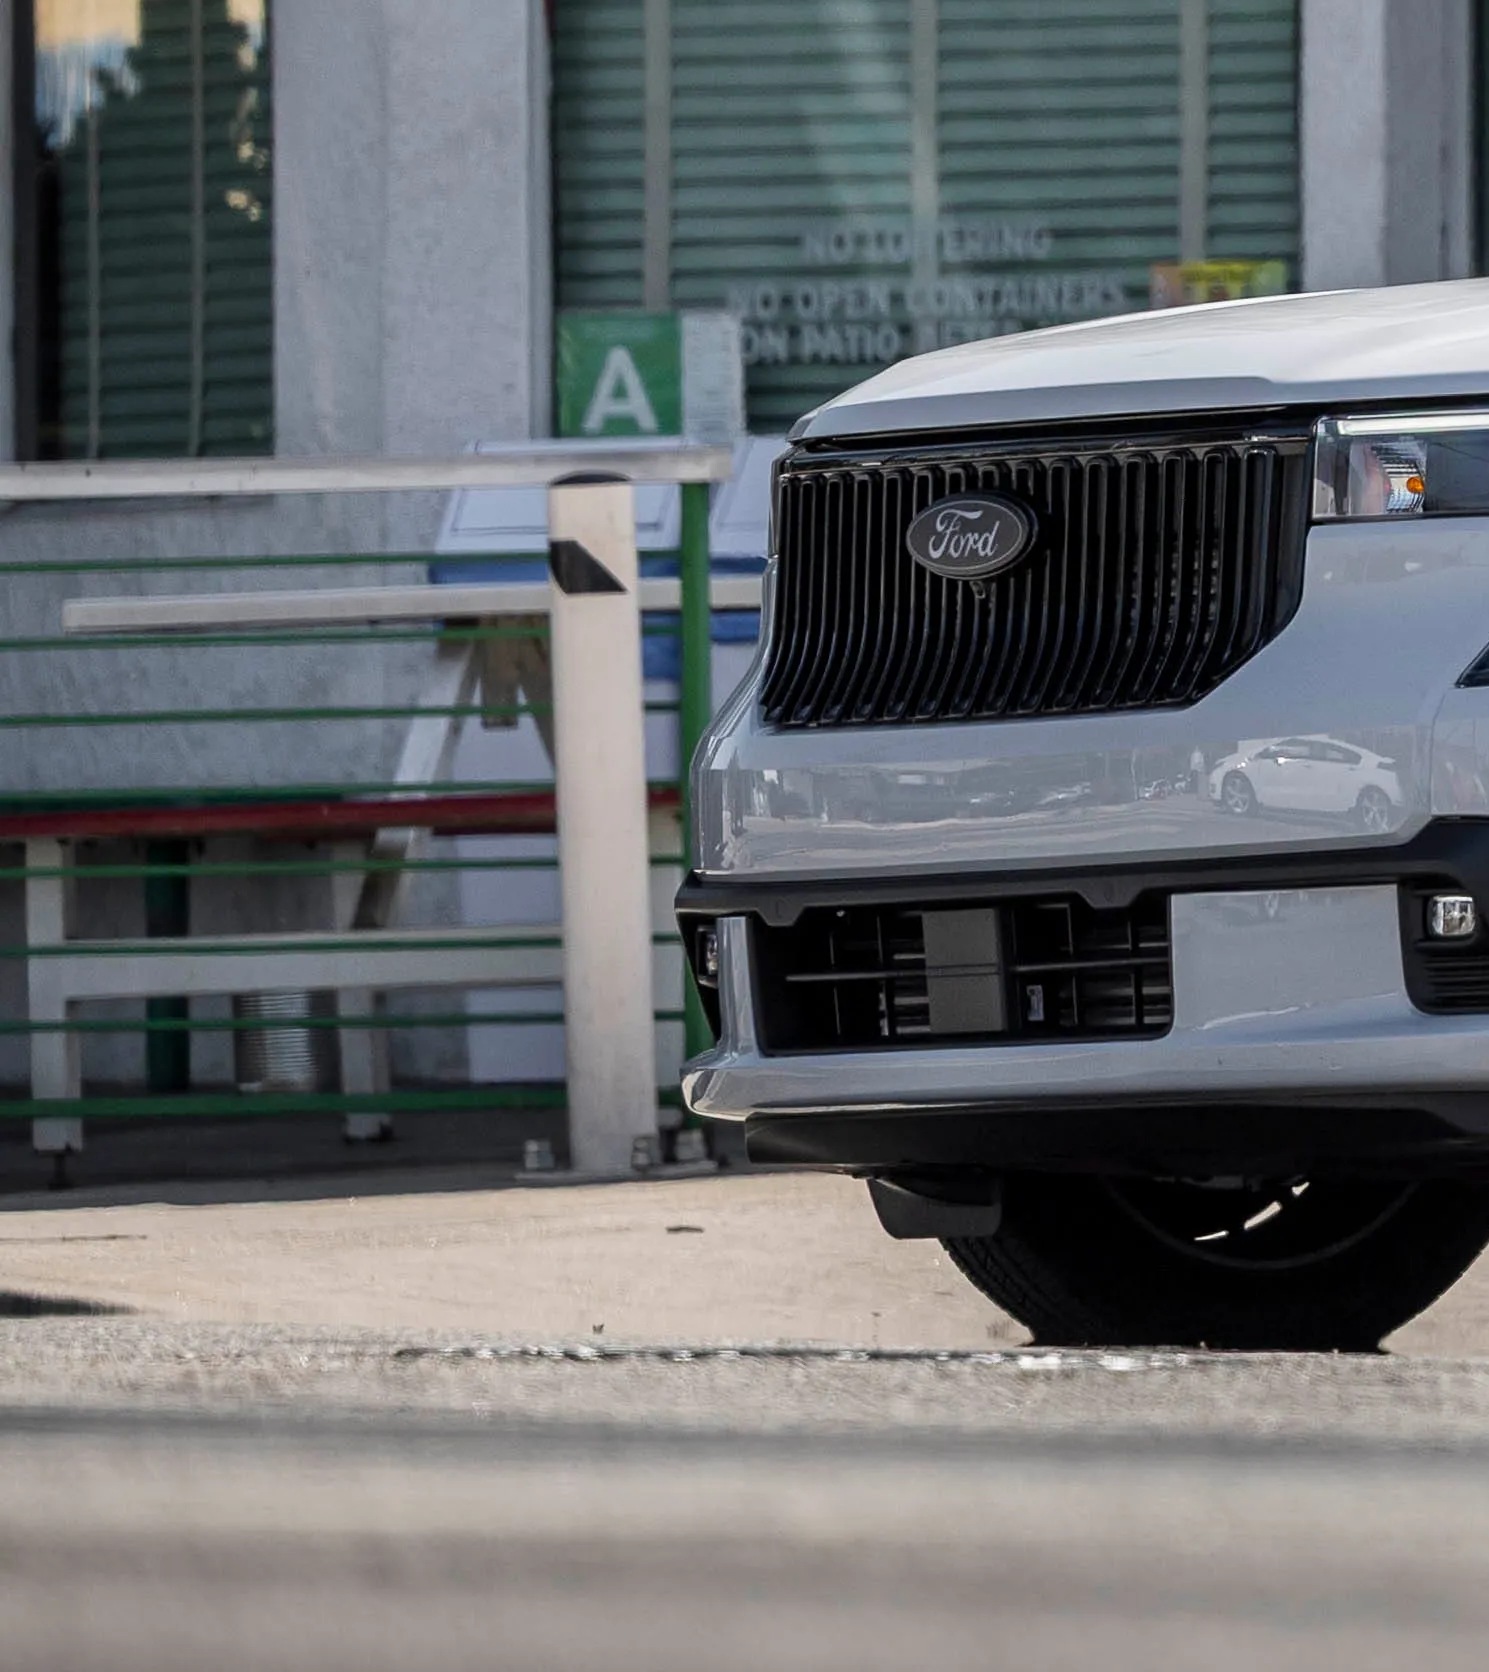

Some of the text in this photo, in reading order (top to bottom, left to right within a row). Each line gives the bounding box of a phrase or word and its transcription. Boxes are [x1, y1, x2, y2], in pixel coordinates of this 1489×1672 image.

[802, 227, 856, 263] NO
[797, 278, 892, 319] OPEN
[803, 323, 901, 364] PATIO
[581, 344, 659, 434] A
[928, 508, 1001, 560] Ford
